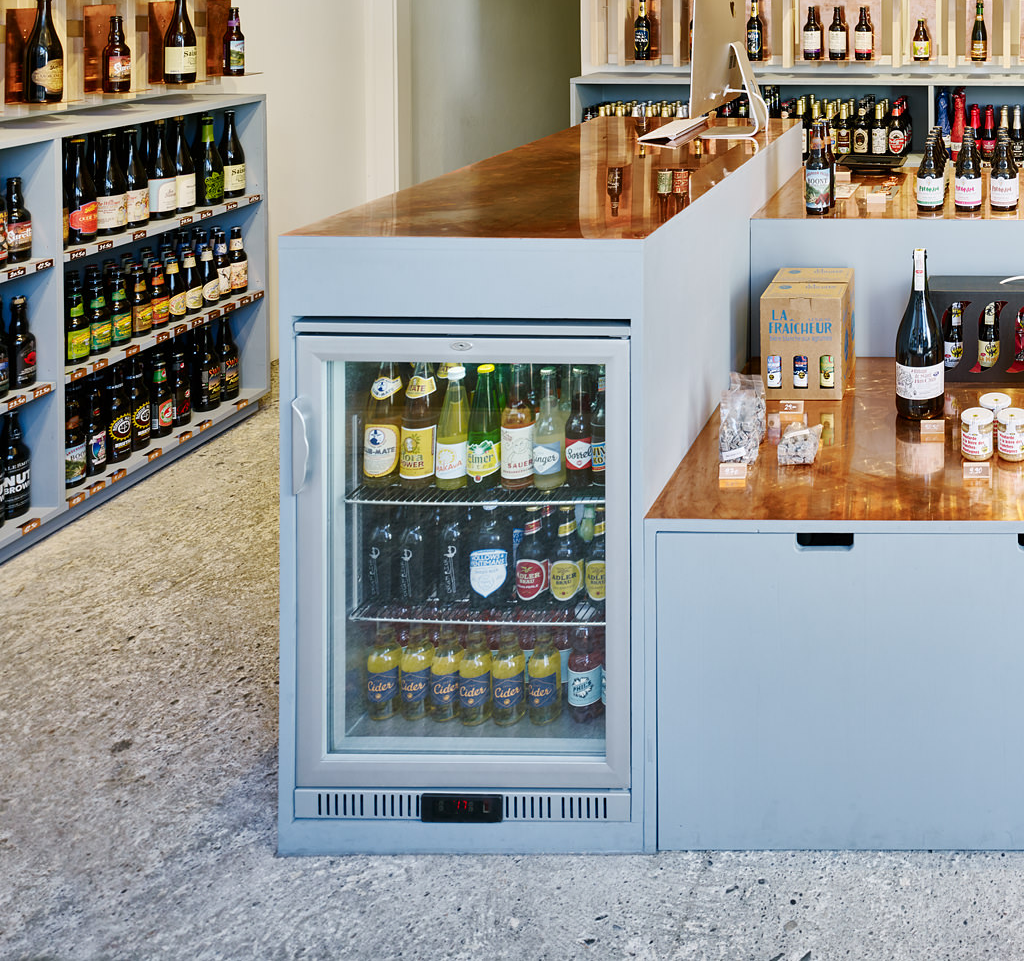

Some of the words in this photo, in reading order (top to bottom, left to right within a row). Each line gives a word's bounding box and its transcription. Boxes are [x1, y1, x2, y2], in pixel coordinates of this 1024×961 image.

[772, 309, 788, 321] LA
[768, 318, 833, 335] FRAÎCHEUR
[5, 468, 30, 487] NUT
[552, 571, 578, 581] ADLER
[367, 679, 394, 692] Cider
[459, 685, 487, 698] Cider
[494, 685, 521, 698] Cider
